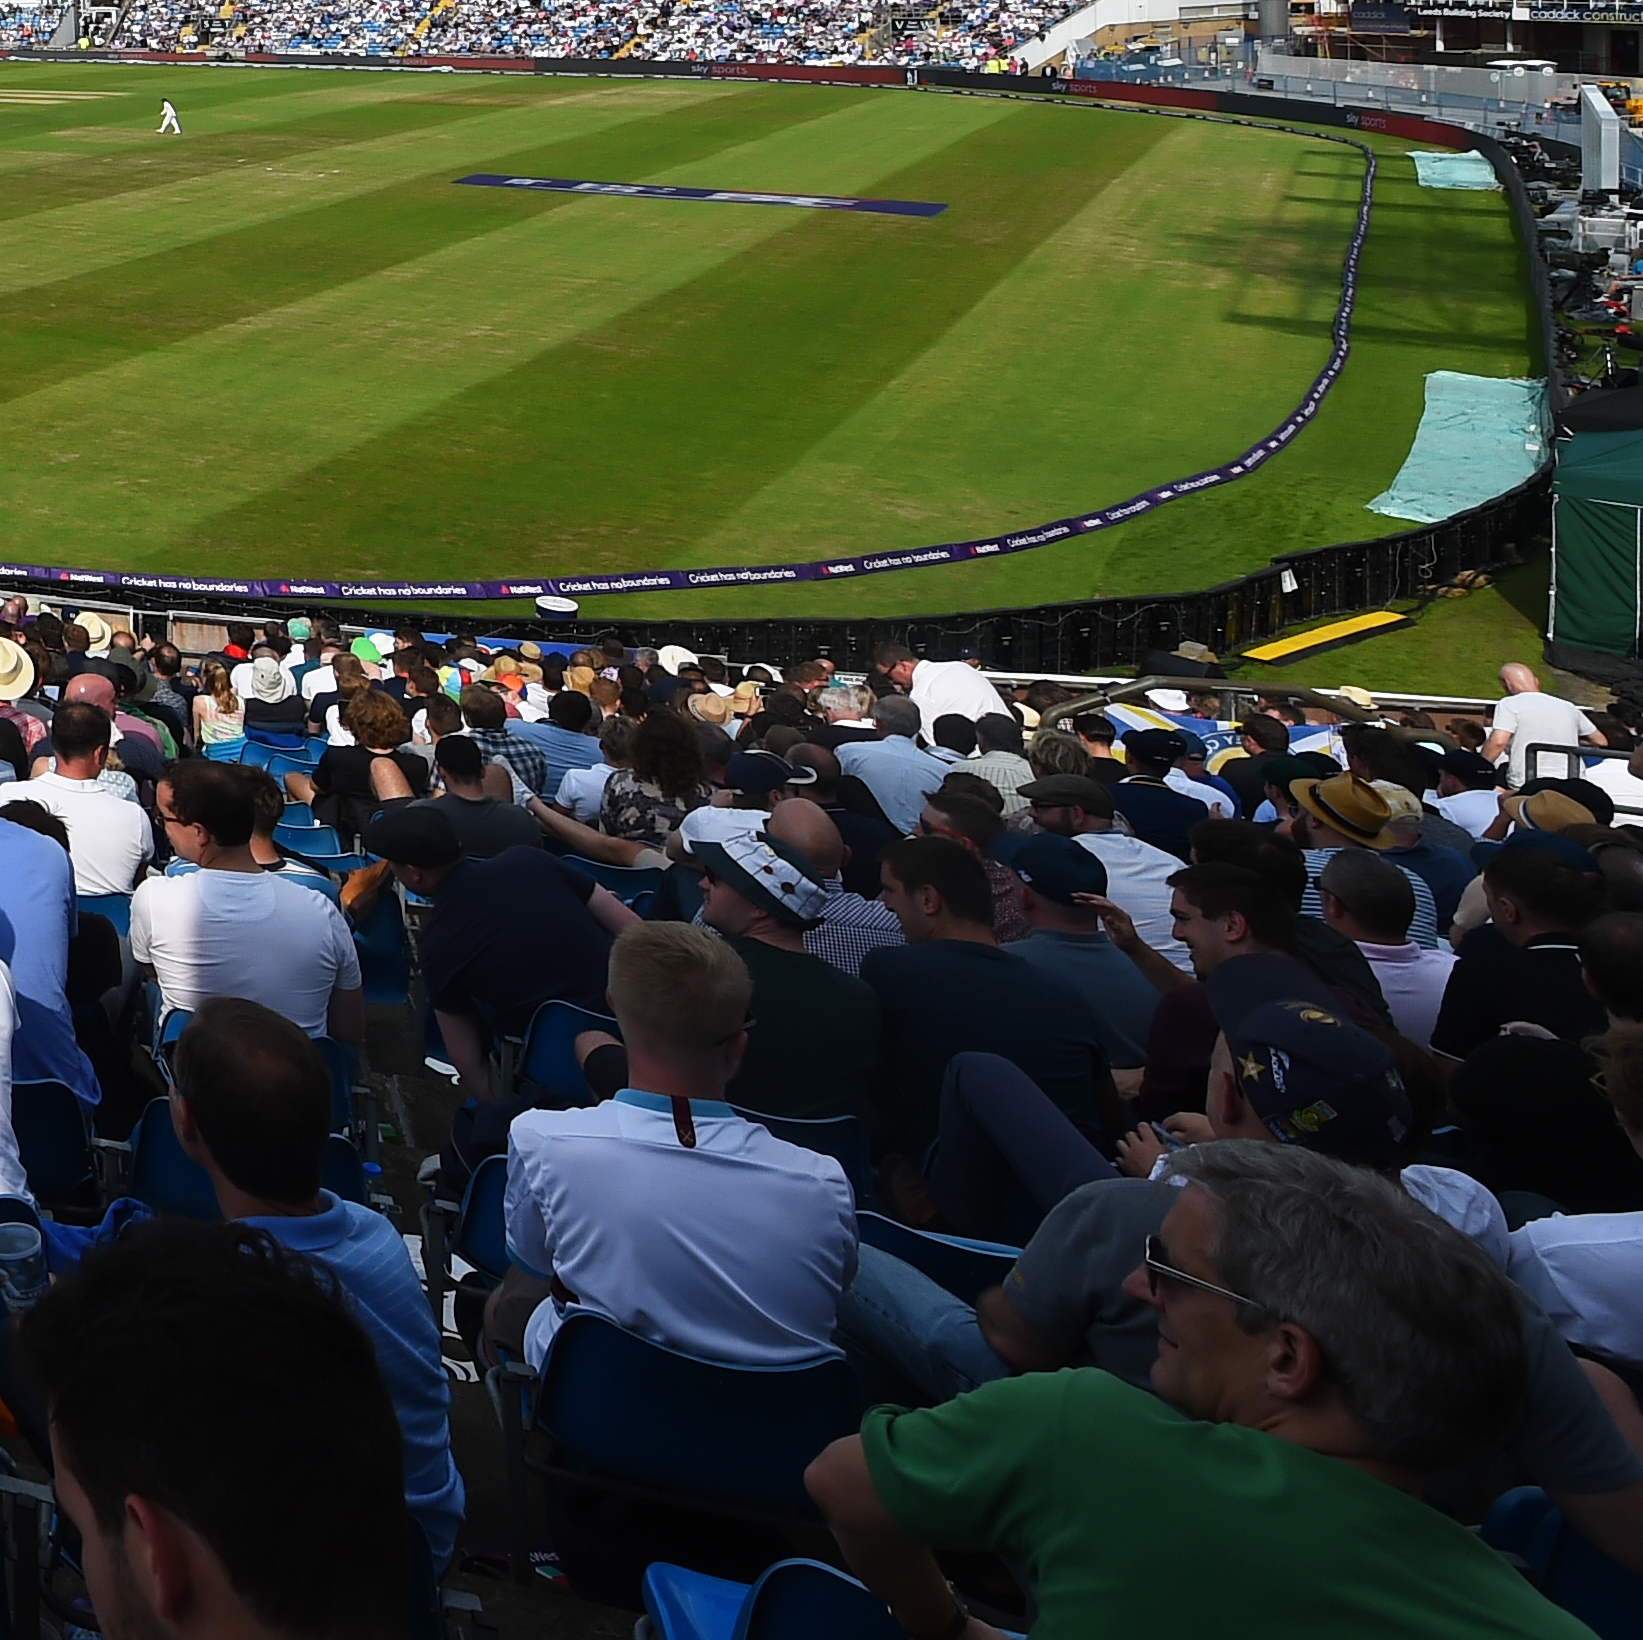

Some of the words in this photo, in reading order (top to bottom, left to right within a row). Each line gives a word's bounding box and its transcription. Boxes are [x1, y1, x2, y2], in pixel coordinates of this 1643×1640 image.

[1442, 8, 1476, 19] Building
[1478, 9, 1510, 20] Society
[1531, 9, 1580, 20] caddick
[691, 64, 709, 74] sky
[712, 64, 747, 74] sports
[1052, 81, 1067, 92] sky
[1069, 83, 1097, 94] sports
[1346, 112, 1359, 126] sky
[1361, 116, 1386, 129] sports
[863, 558, 889, 569] Cricket
[913, 547, 950, 561] boundaries
[827, 562, 855, 573] NatWest
[70, 573, 104, 583] NatWest
[689, 569, 718, 583] Cricket
[719, 571, 736, 581] has
[737, 570, 748, 579] no
[748, 568, 796, 581] boundaries
[121, 576, 156, 587] Cricket
[158, 579, 176, 588] has
[192, 580, 258, 592] boundaries
[509, 584, 543, 594] NatWest
[559, 581, 591, 592] Cricket
[592, 581, 609, 590] has
[623, 576, 671, 588] boundaries
[290, 585, 325, 595] NatWest
[341, 585, 376, 596] Cricket
[378, 585, 395, 596] has
[411, 585, 466, 595] boundaries
